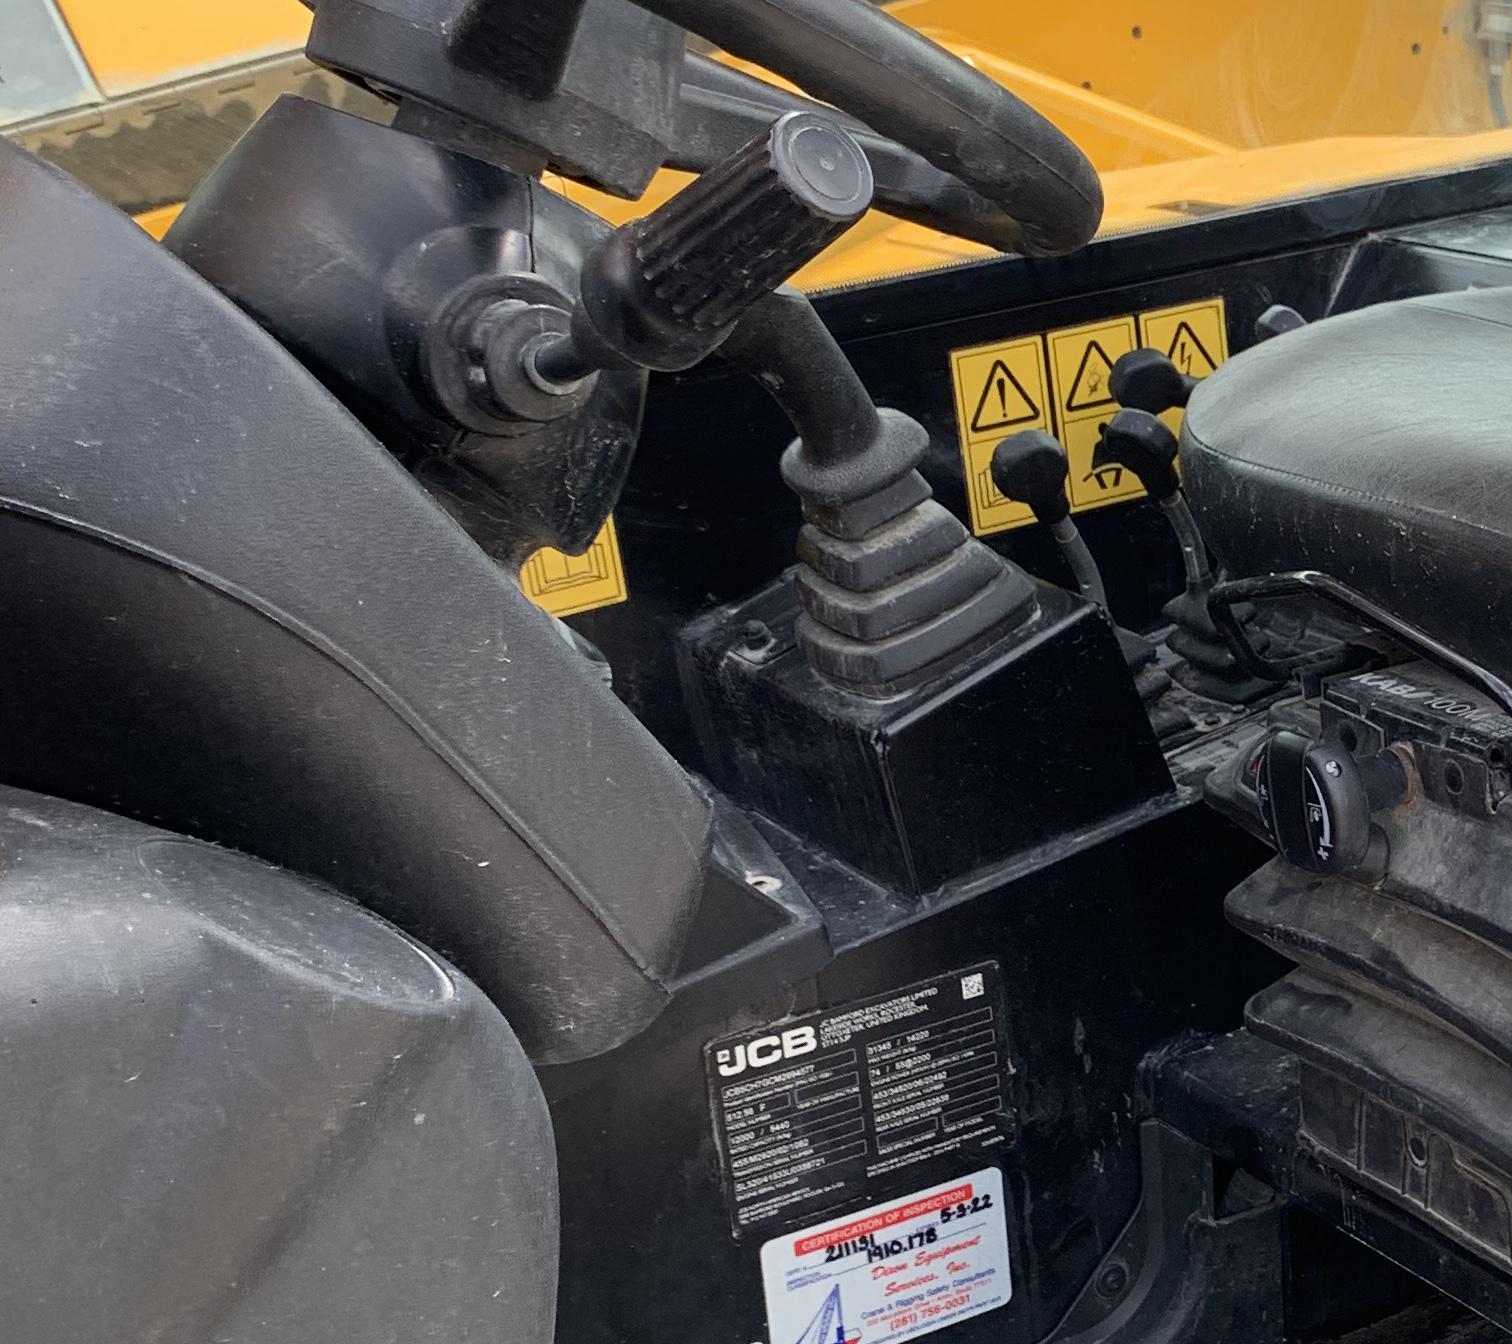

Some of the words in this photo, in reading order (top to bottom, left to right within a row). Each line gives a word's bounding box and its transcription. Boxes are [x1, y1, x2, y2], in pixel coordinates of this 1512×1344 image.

[910, 986, 937, 1001] LIMITED
[716, 1025, 818, 1077] JCB
[801, 1217, 883, 1251] CERTIFICATION
[885, 1211, 901, 1225] OF
[902, 1188, 967, 1219] INSPECTION
[867, 1227, 939, 1264] 1910.178
[914, 1235, 981, 1267] Equipment
[860, 1305, 884, 1321] Crane
[894, 1291, 924, 1310] Rigging
[926, 1281, 949, 1298] Safety
[953, 1265, 995, 1288] Consultants
